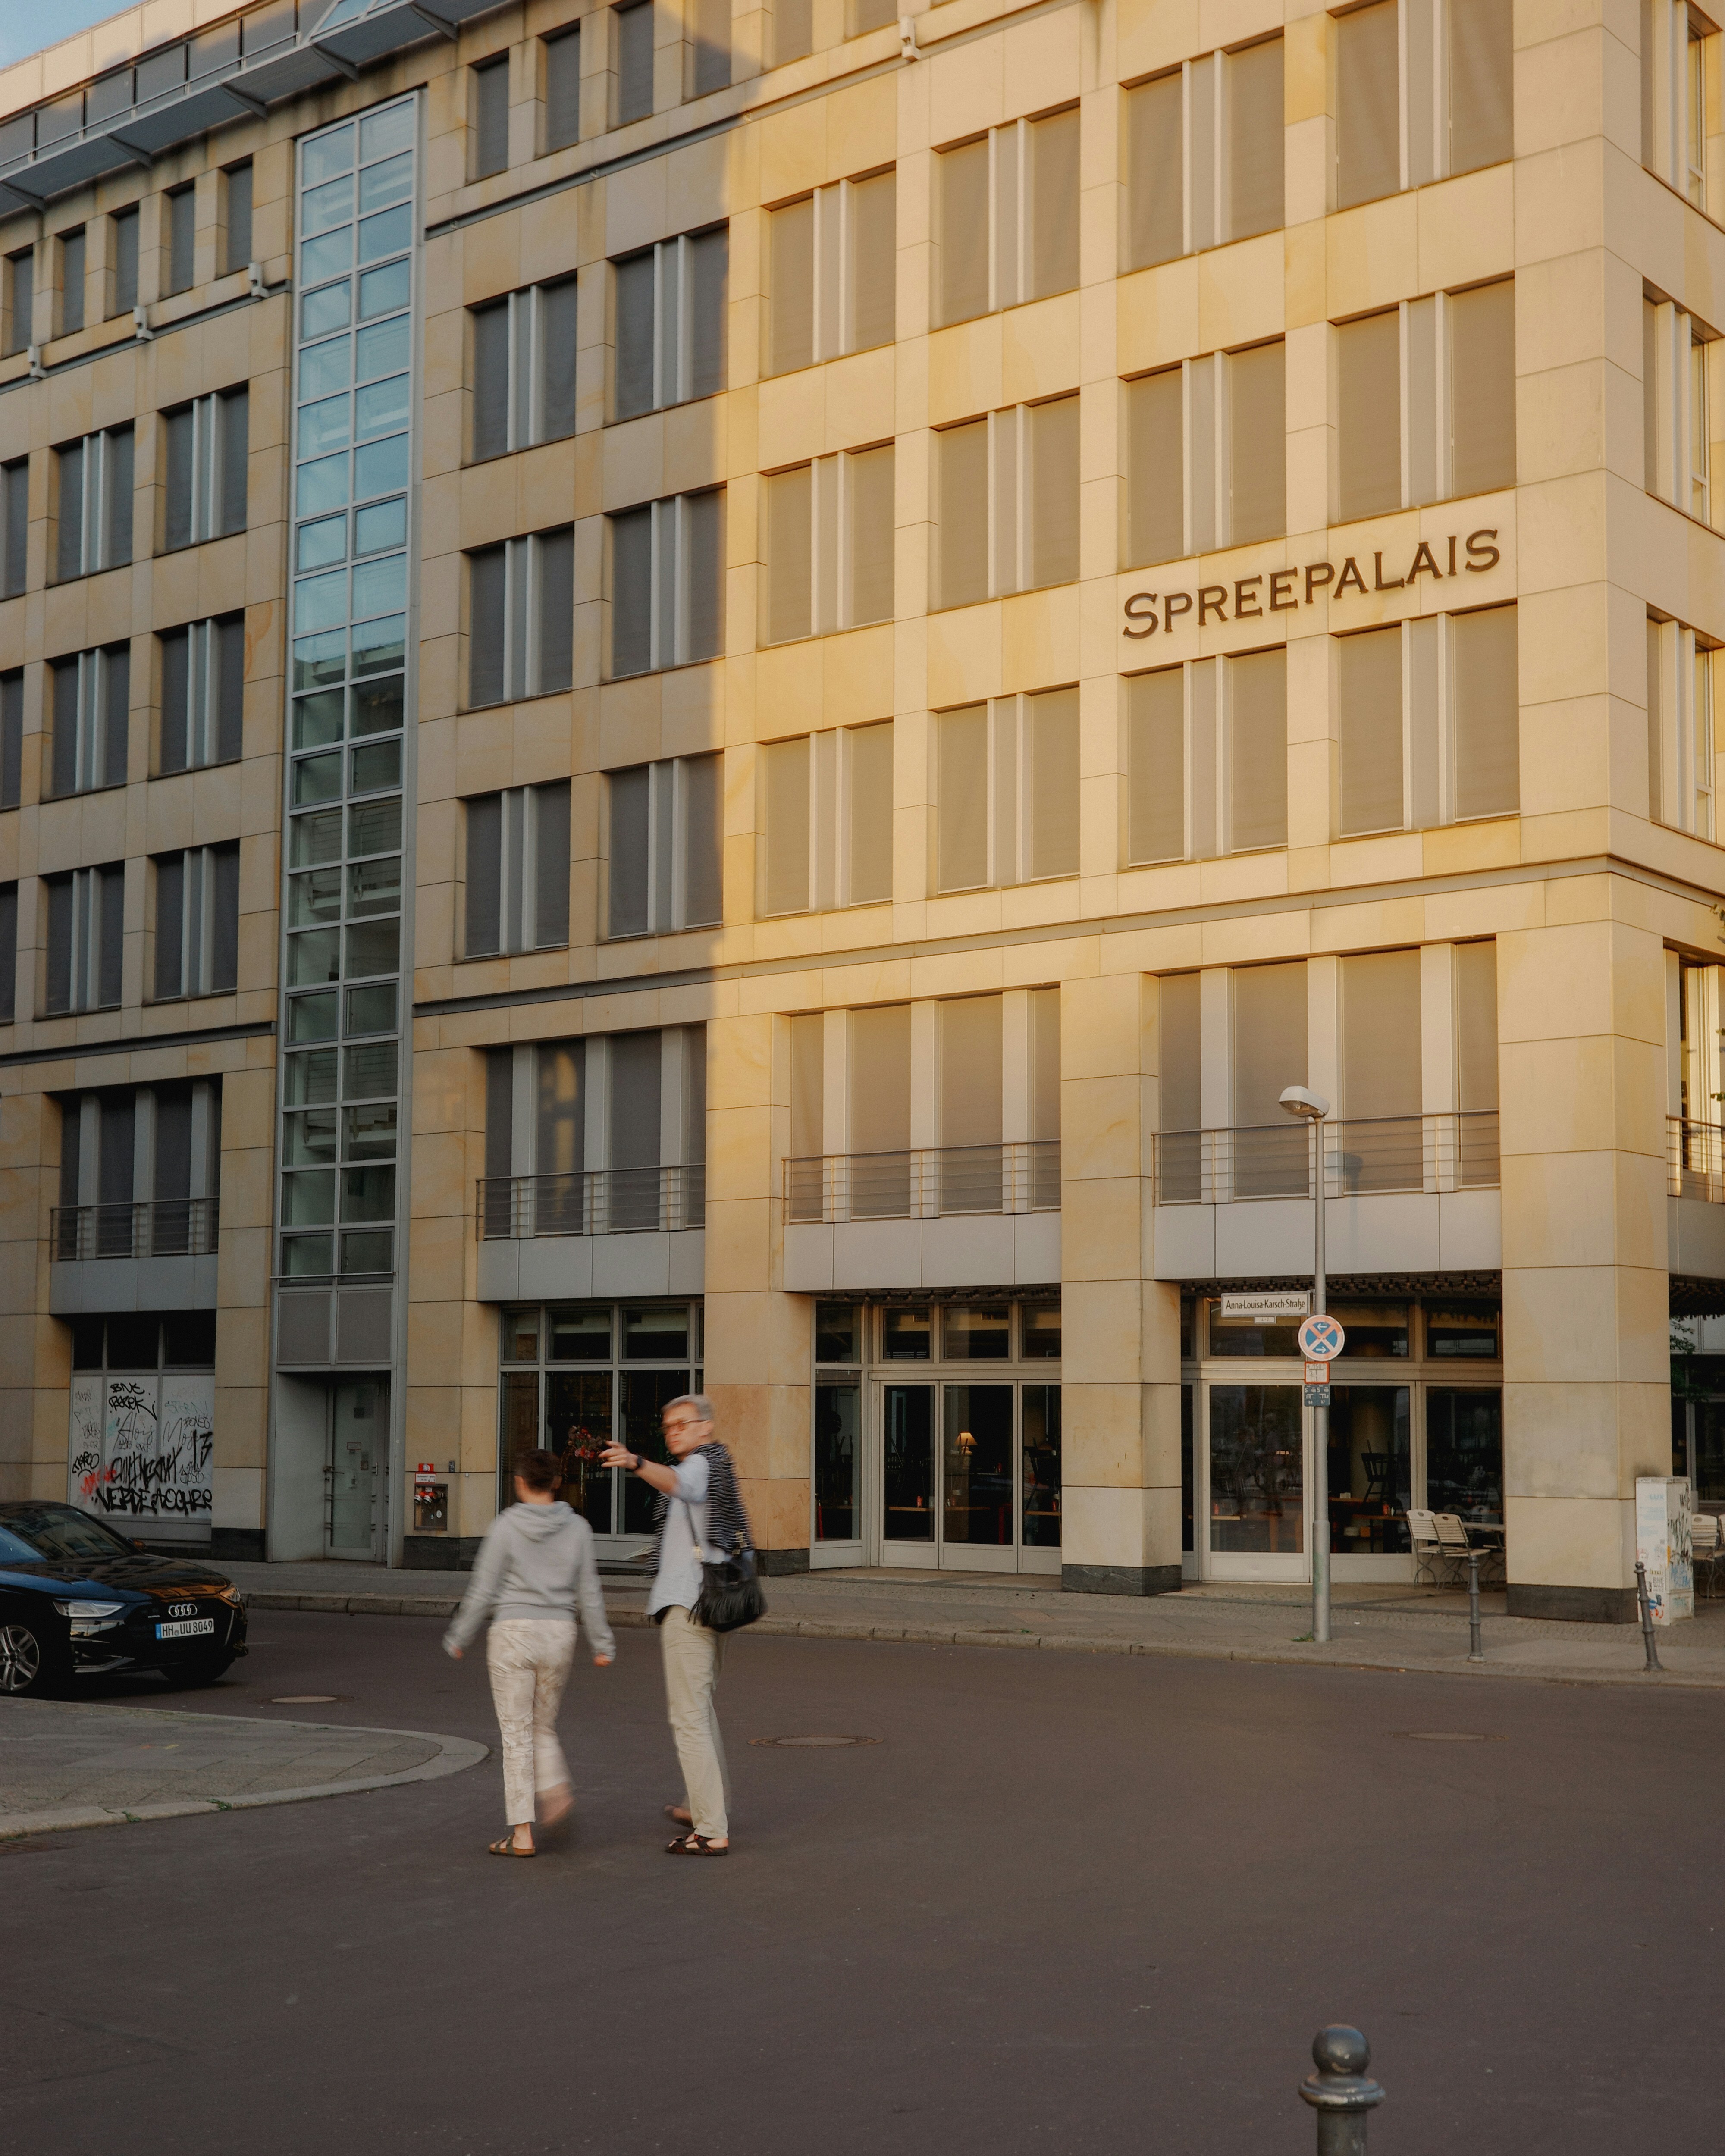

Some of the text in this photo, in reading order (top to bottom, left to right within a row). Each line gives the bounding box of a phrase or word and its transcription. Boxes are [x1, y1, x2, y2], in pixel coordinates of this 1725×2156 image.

[1122, 529, 1500, 639] SPREEPALAIS
[1226, 1298, 1305, 1310] Anna-Louisa-Karsch-Straße
[163, 1620, 213, 1636] HH UU 8049
